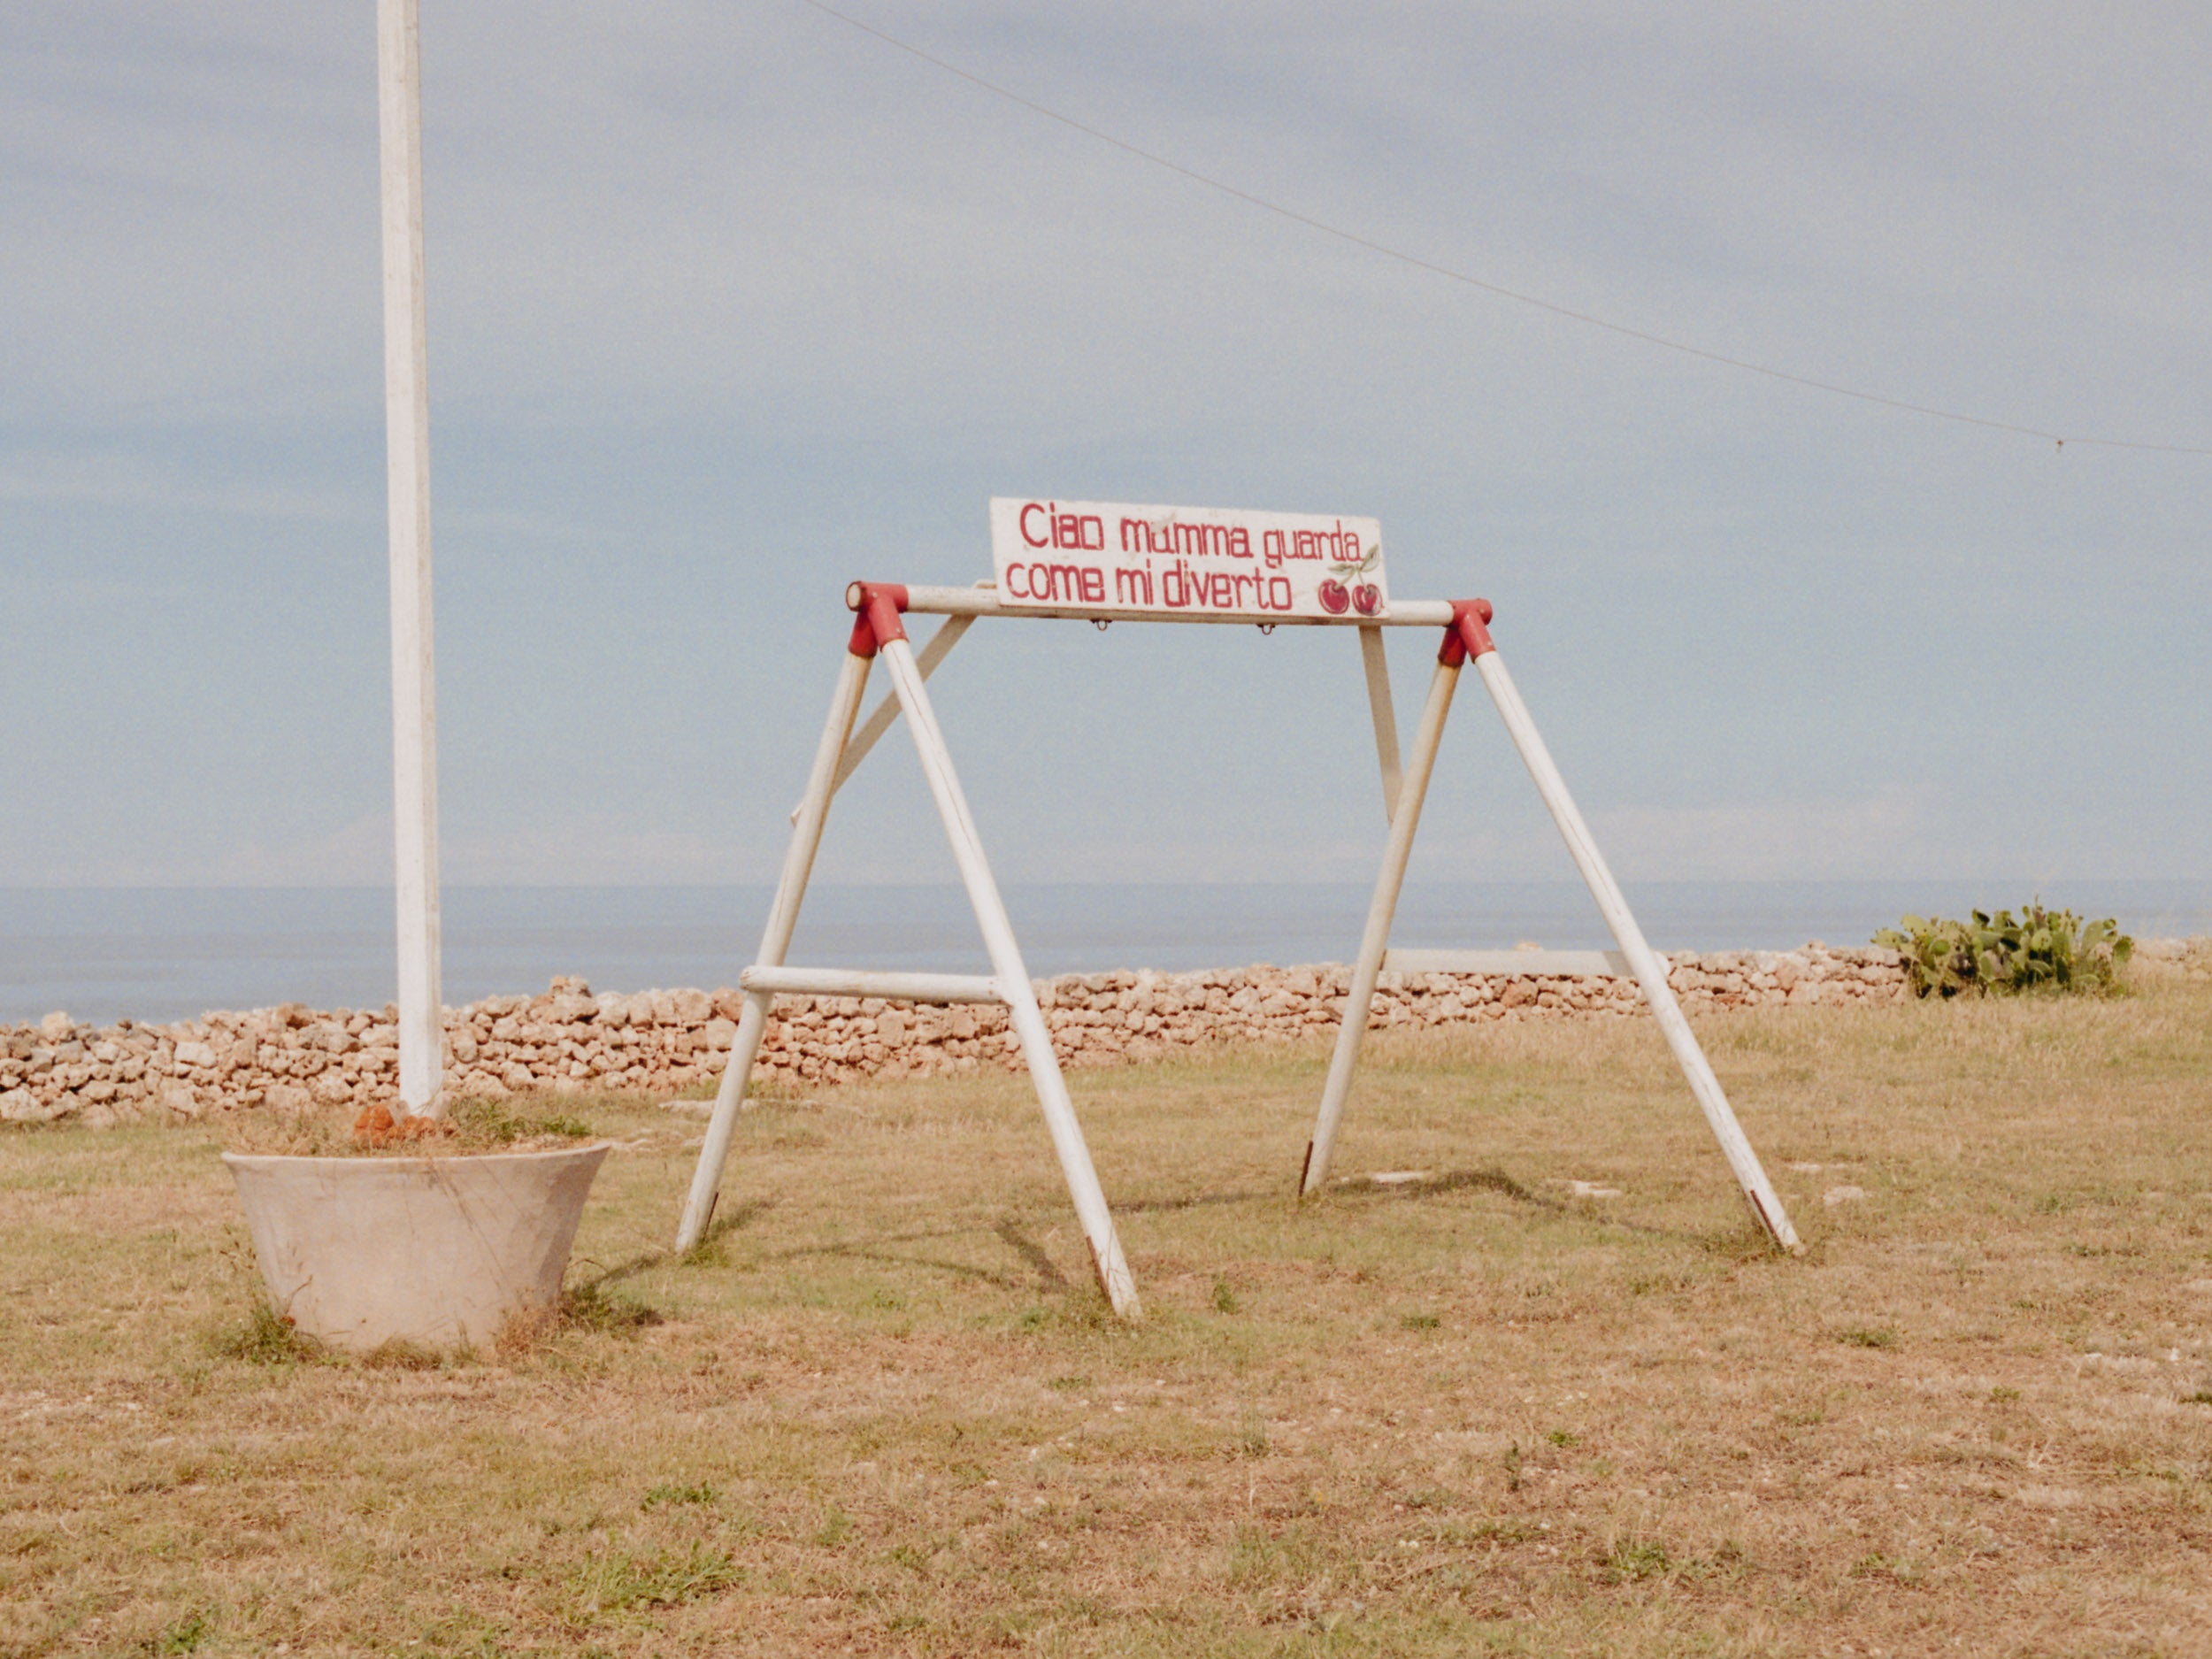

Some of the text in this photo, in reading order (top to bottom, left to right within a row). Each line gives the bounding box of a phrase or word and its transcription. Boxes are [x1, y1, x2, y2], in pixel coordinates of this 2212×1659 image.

[1019, 503, 1105, 550] Ciao
[1263, 520, 1363, 569] guarda
[1006, 558, 1293, 611] come mi diverto
